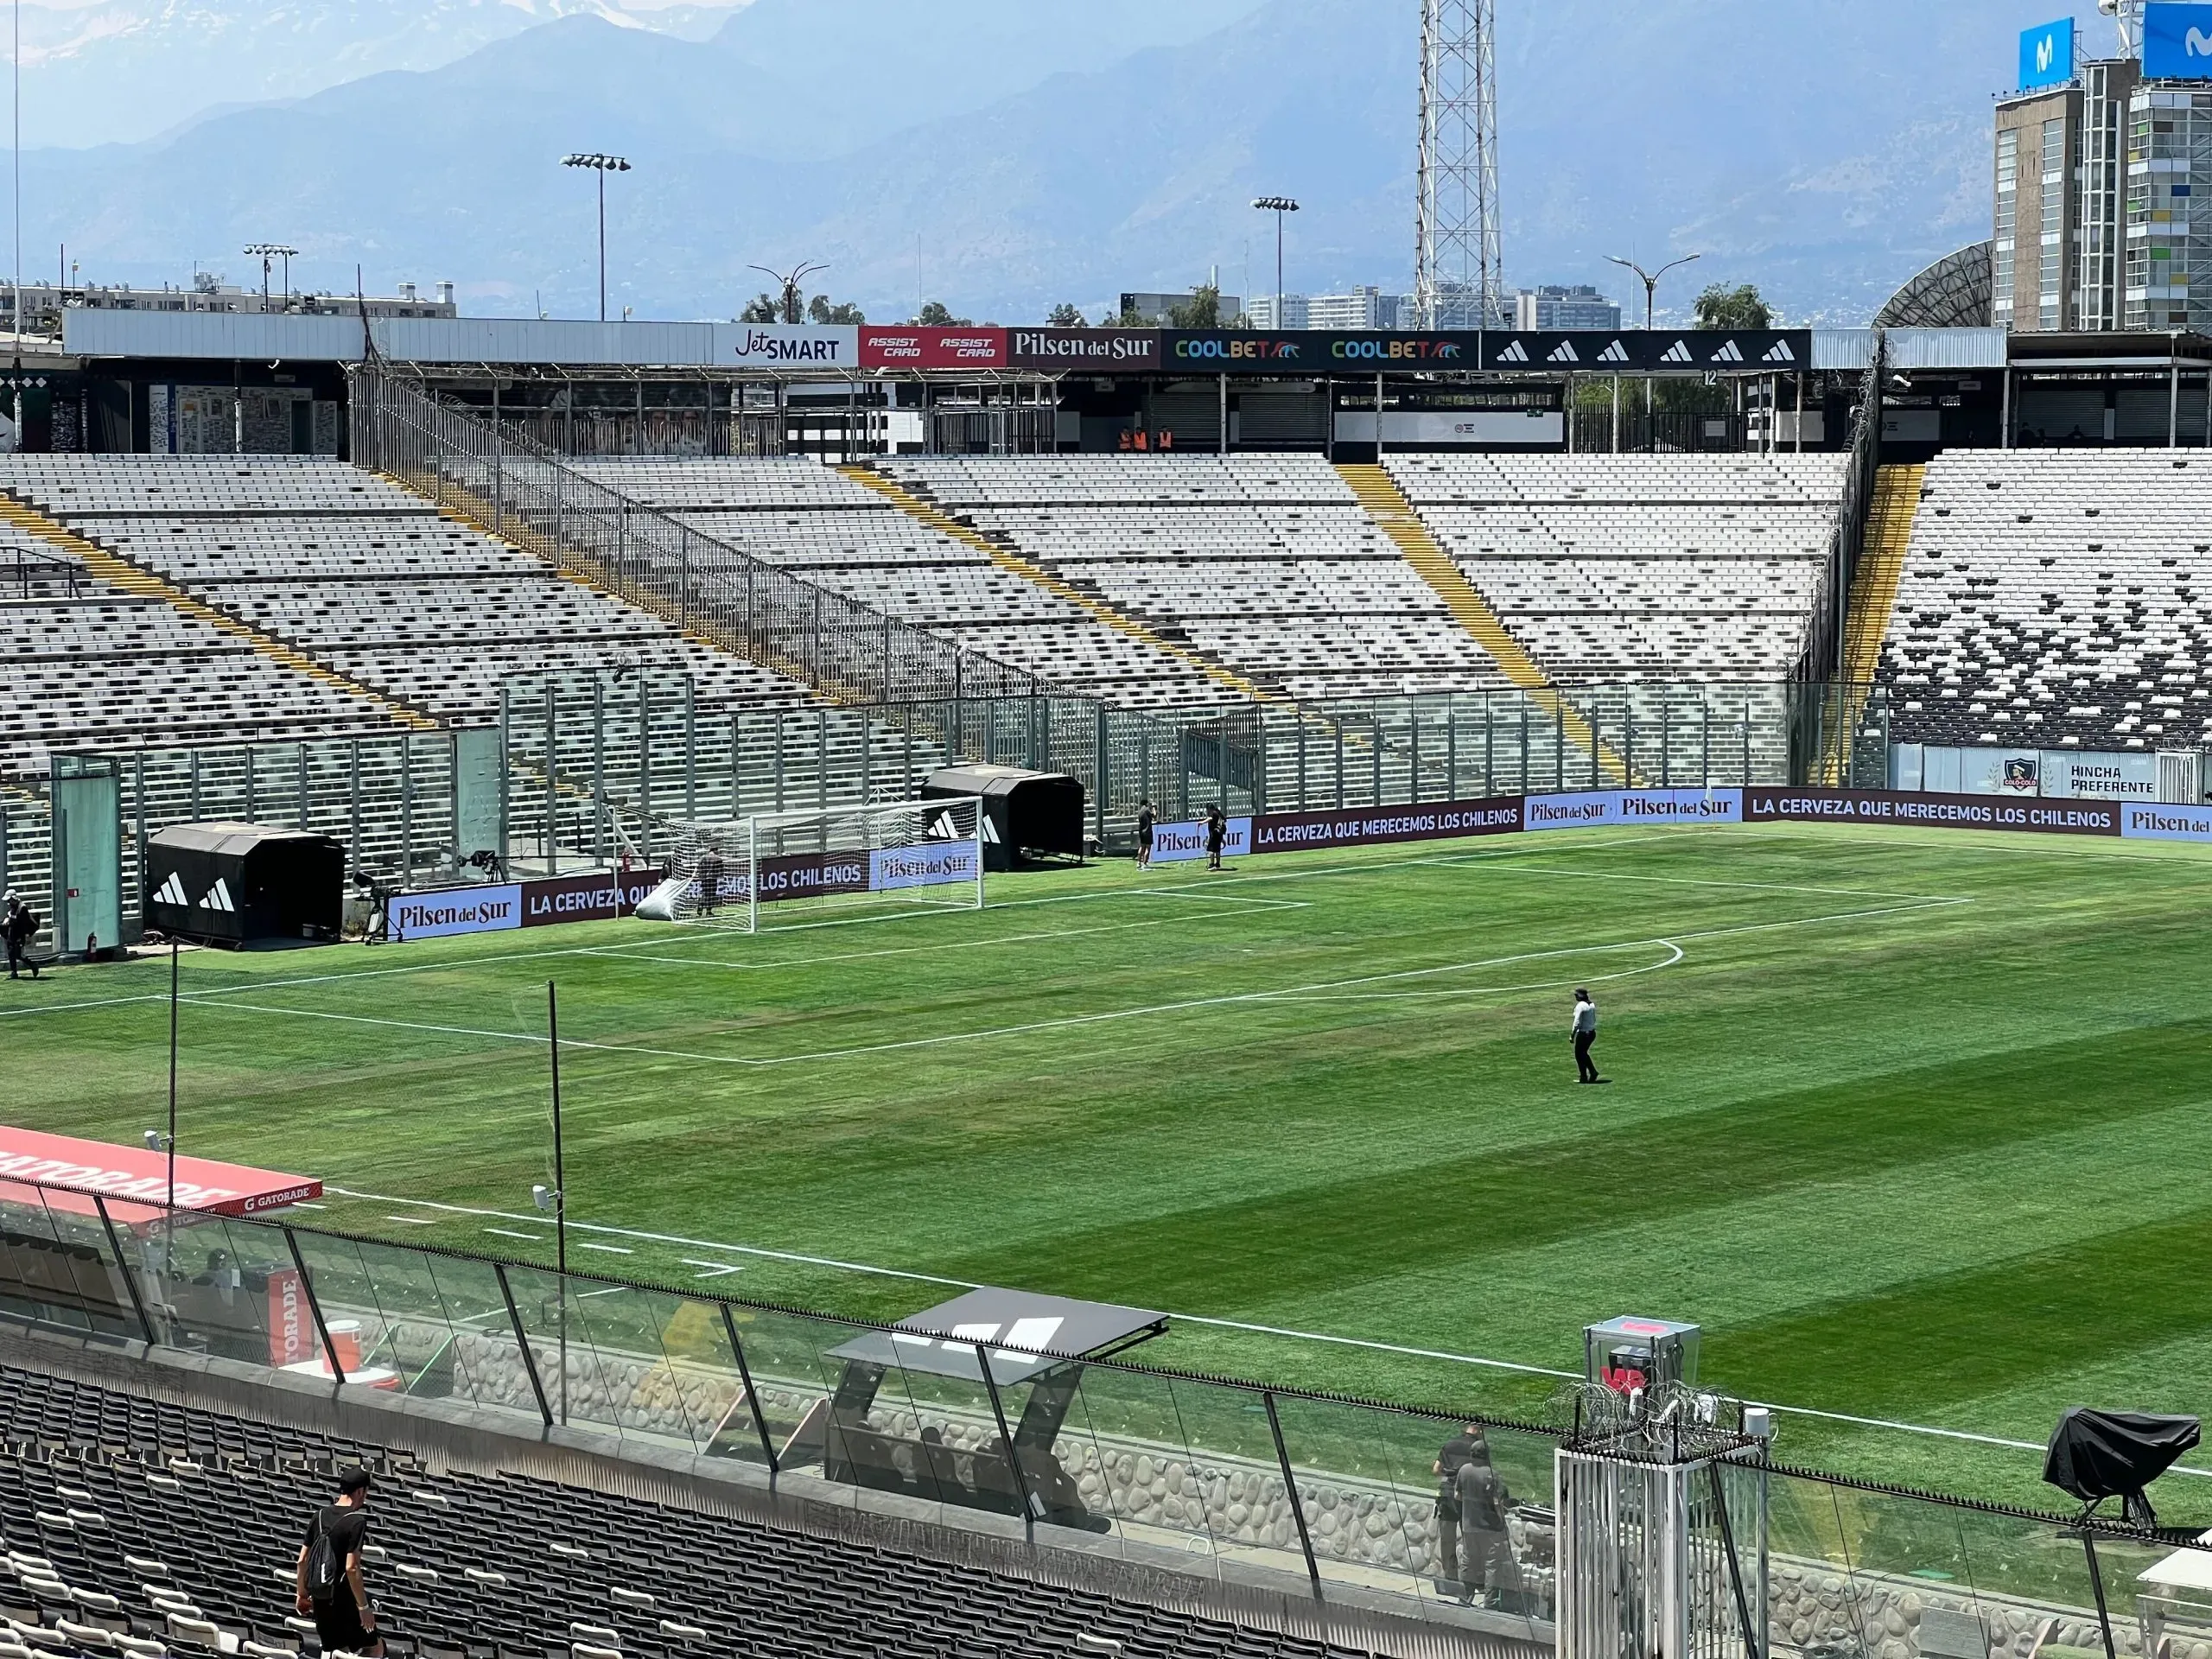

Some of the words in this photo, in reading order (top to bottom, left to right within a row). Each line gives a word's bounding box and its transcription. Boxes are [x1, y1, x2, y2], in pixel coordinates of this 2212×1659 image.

[735, 329, 840, 360] JetSMART
[868, 338, 918, 347] ASSIST
[939, 338, 993, 347] ASSIST
[1014, 333, 1085, 356] Pilsen
[1087, 340, 1109, 356] del
[1112, 337, 1154, 359] Sur
[1175, 340, 1271, 359] COOLBET
[1332, 340, 1433, 359] COOLBET
[883, 347, 921, 358] CARD
[956, 348, 995, 358] CARD
[854, 366, 864, 379] 13
[1703, 370, 1717, 385] 12
[2071, 765, 2121, 779] HINCHA
[2071, 779, 2154, 793] PREFERENTE
[1530, 803, 1568, 821] Pilsen
[1568, 805, 1581, 819] del
[1583, 803, 1605, 820] Sur
[1621, 798, 1676, 816] Pilsen
[1679, 802, 1697, 814] del
[1700, 799, 1732, 817] Sur
[1752, 798, 1776, 814] LA
[1779, 798, 1855, 816] CERVEZA
[1859, 800, 1891, 817] QUE
[1895, 802, 1992, 823] MERECEMOS
[1995, 808, 2027, 824] LOS
[2030, 809, 2111, 829] CHILENOS
[1258, 828, 1274, 844] LA
[1277, 823, 1332, 842] CERVEZA
[1335, 820, 1360, 838] QUE
[1362, 815, 1435, 836] MERECEMOS
[1438, 812, 1460, 830] LOS
[1462, 808, 1517, 828] CHILENOS
[2132, 811, 2190, 832] Pilsen
[2191, 820, 2209, 833] del
[1157, 830, 1201, 852] Pilsen
[926, 860, 941, 874] del
[943, 855, 970, 876] Sur
[531, 896, 552, 915] LA
[555, 887, 626, 912] CERVEZA
[760, 871, 787, 891] LOS
[791, 864, 861, 887] CHILENOS
[399, 905, 456, 929] Pilsen
[459, 906, 476, 923] del
[479, 900, 512, 924] Sur
[0, 1151, 238, 1206] ATORADE
[257, 1187, 310, 1207] GATORADE
